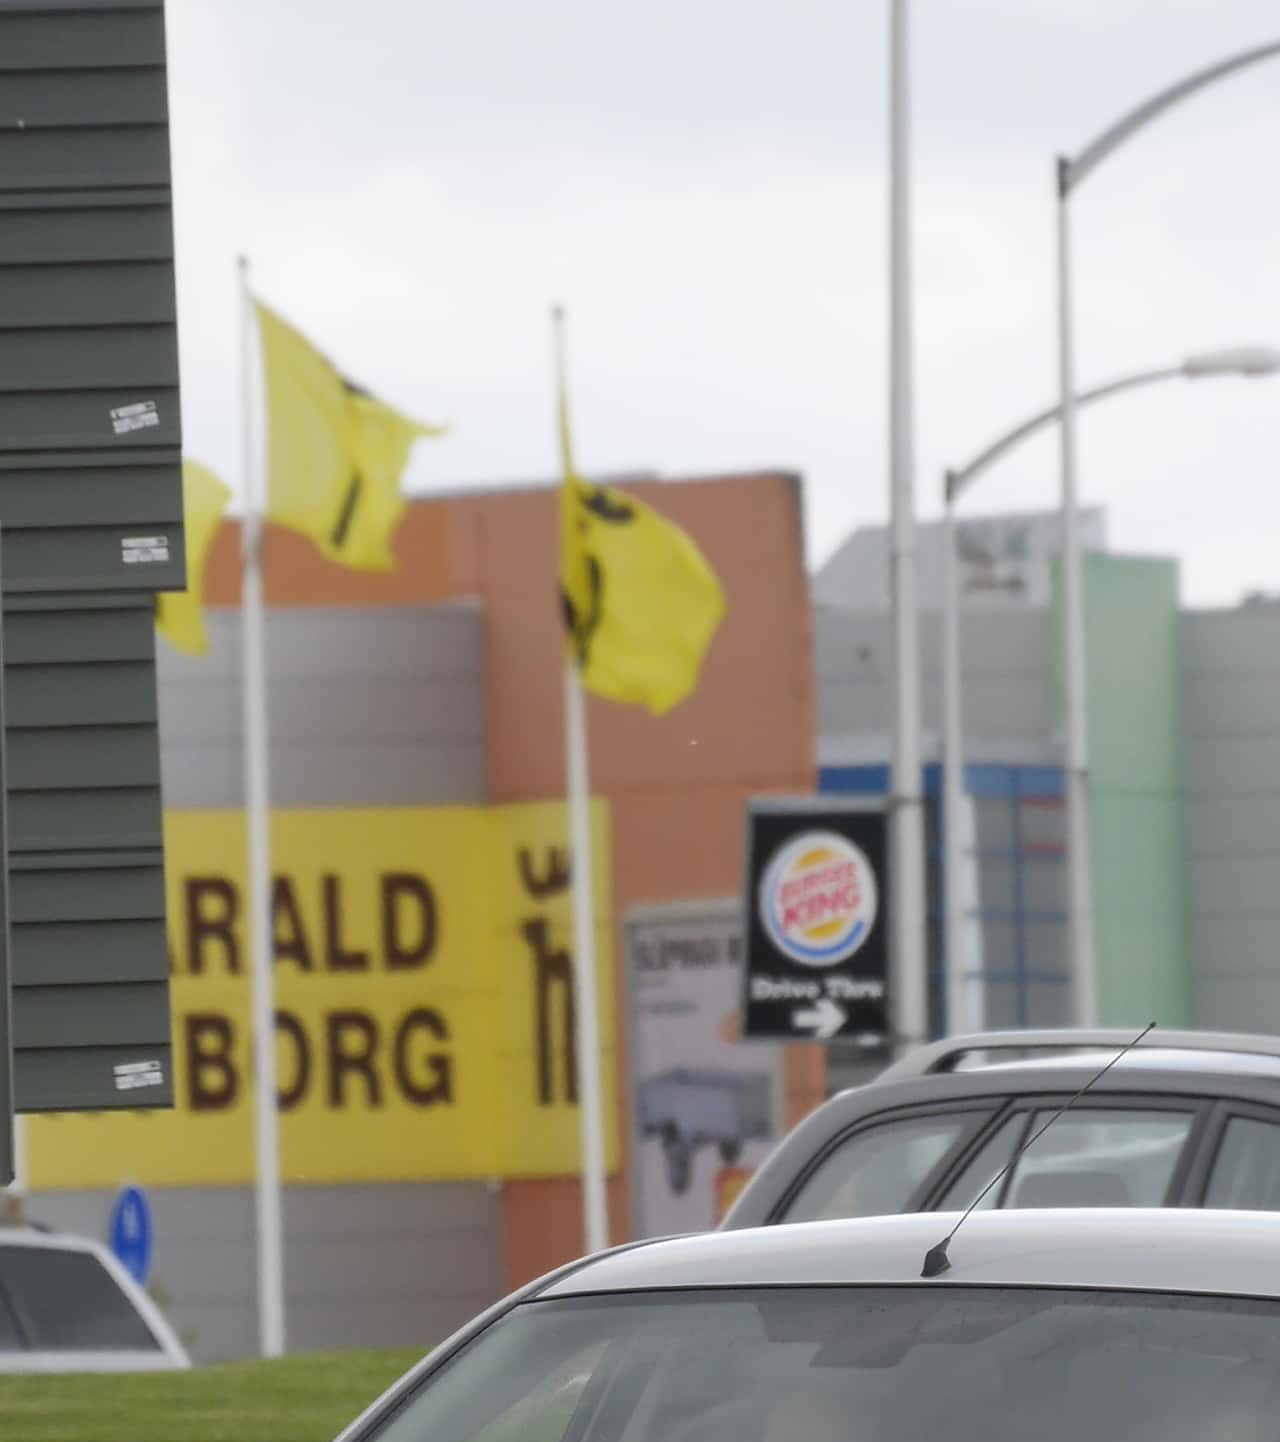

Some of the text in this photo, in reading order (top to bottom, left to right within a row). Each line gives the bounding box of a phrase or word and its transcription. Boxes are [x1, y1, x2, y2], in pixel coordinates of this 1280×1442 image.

[169, 871, 440, 977] RALD
[782, 886, 861, 936] KING
[751, 976, 820, 999] Drive
